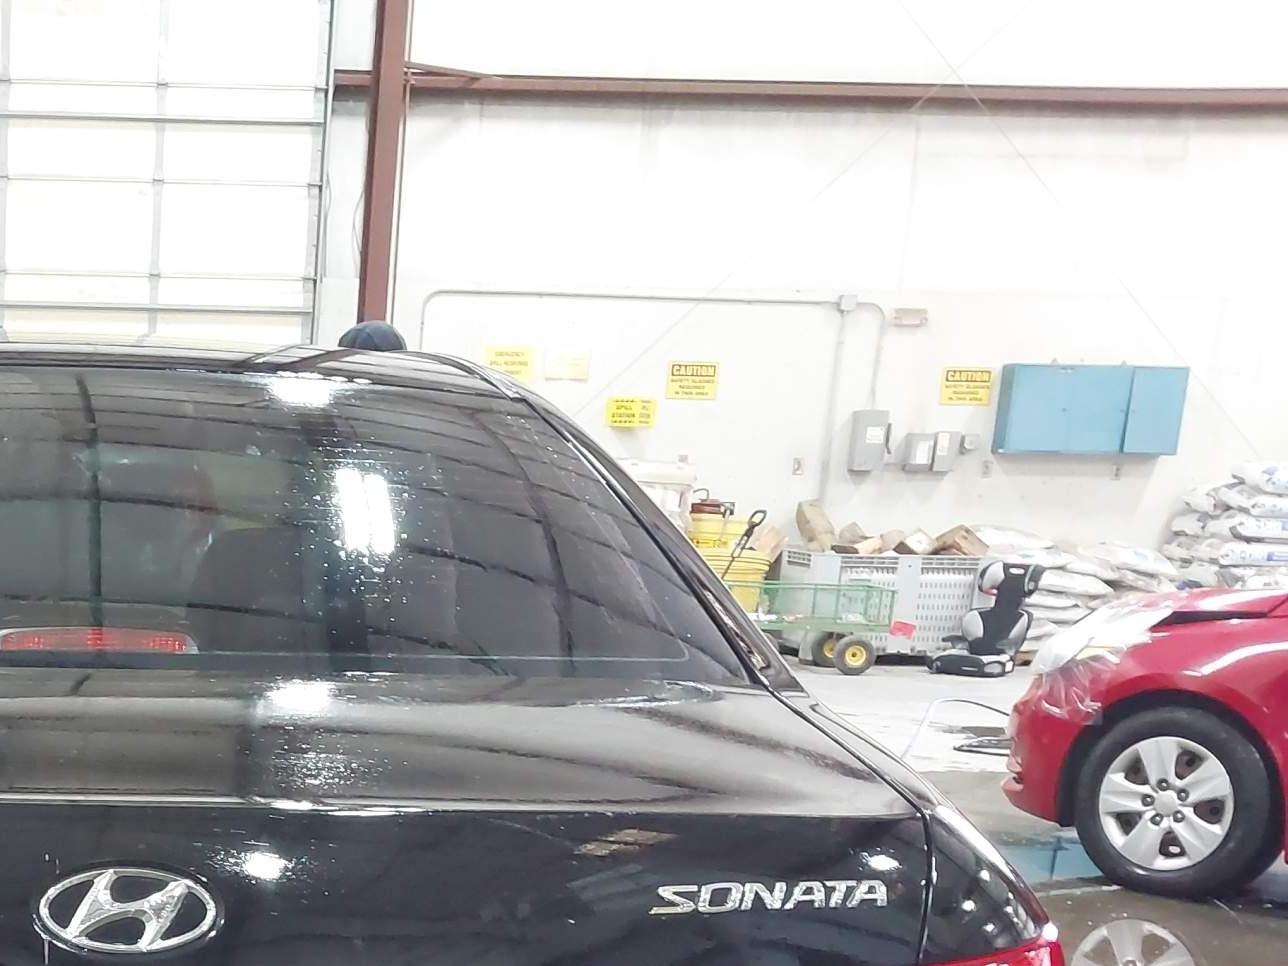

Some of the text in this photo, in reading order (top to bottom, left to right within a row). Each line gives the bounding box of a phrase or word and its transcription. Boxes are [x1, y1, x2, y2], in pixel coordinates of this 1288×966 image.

[673, 365, 715, 377] CAUTION
[947, 370, 990, 382] CAUTION
[648, 879, 889, 915] SONATA
